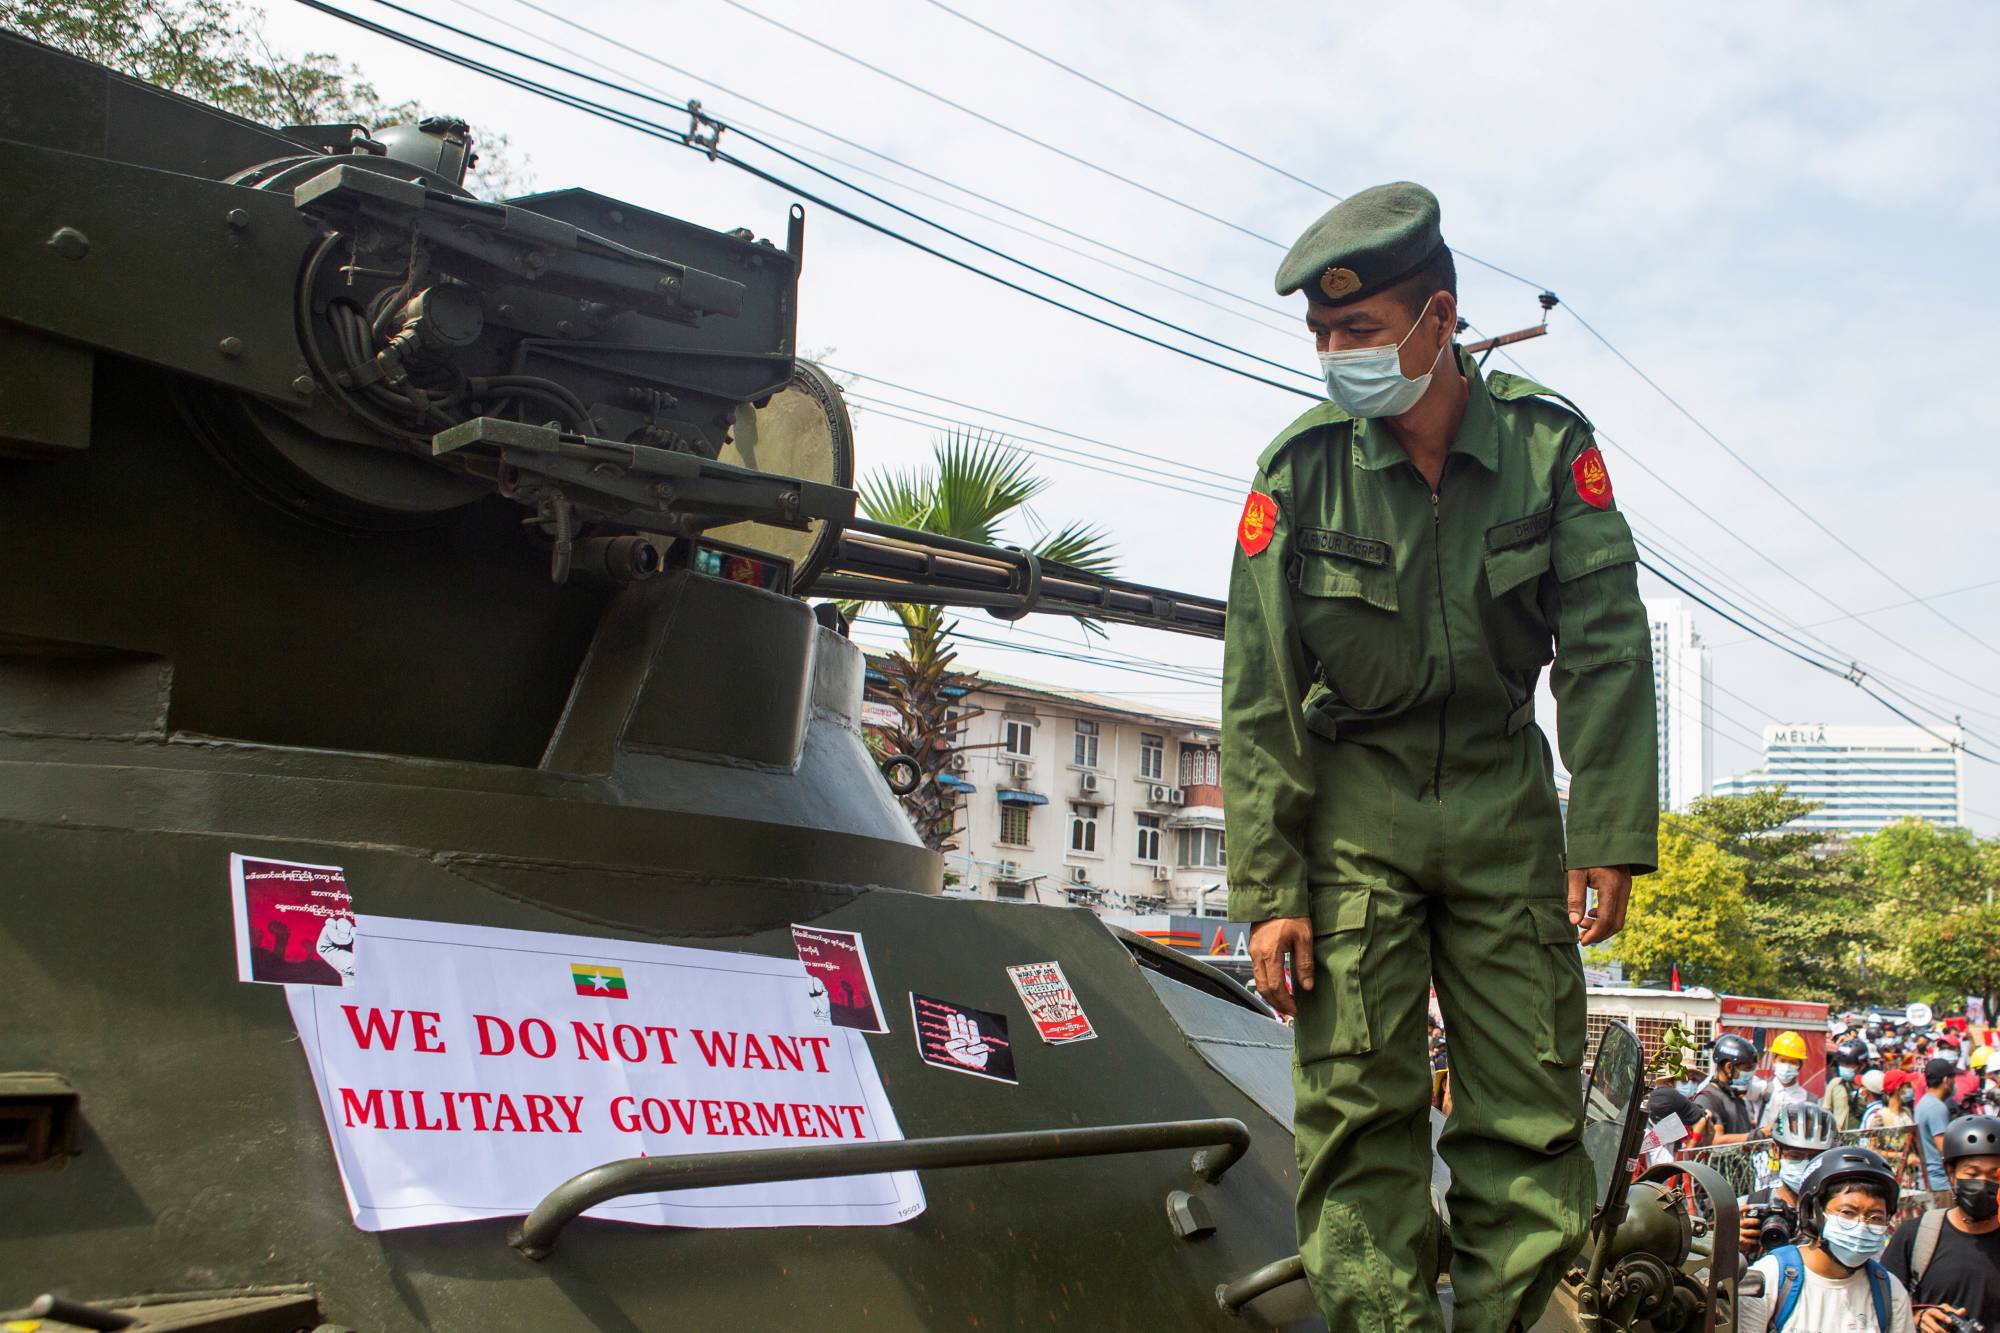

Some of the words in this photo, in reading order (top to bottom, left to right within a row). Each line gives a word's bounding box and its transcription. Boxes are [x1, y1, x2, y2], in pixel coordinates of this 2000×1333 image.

[342, 1005, 446, 1054] WE
[475, 1015, 557, 1060] DO
[575, 1021, 678, 1065] NOT
[691, 1030, 831, 1073] WANT
[339, 1088, 584, 1134] MILITARY
[609, 1096, 867, 1139] GOVERMENT
